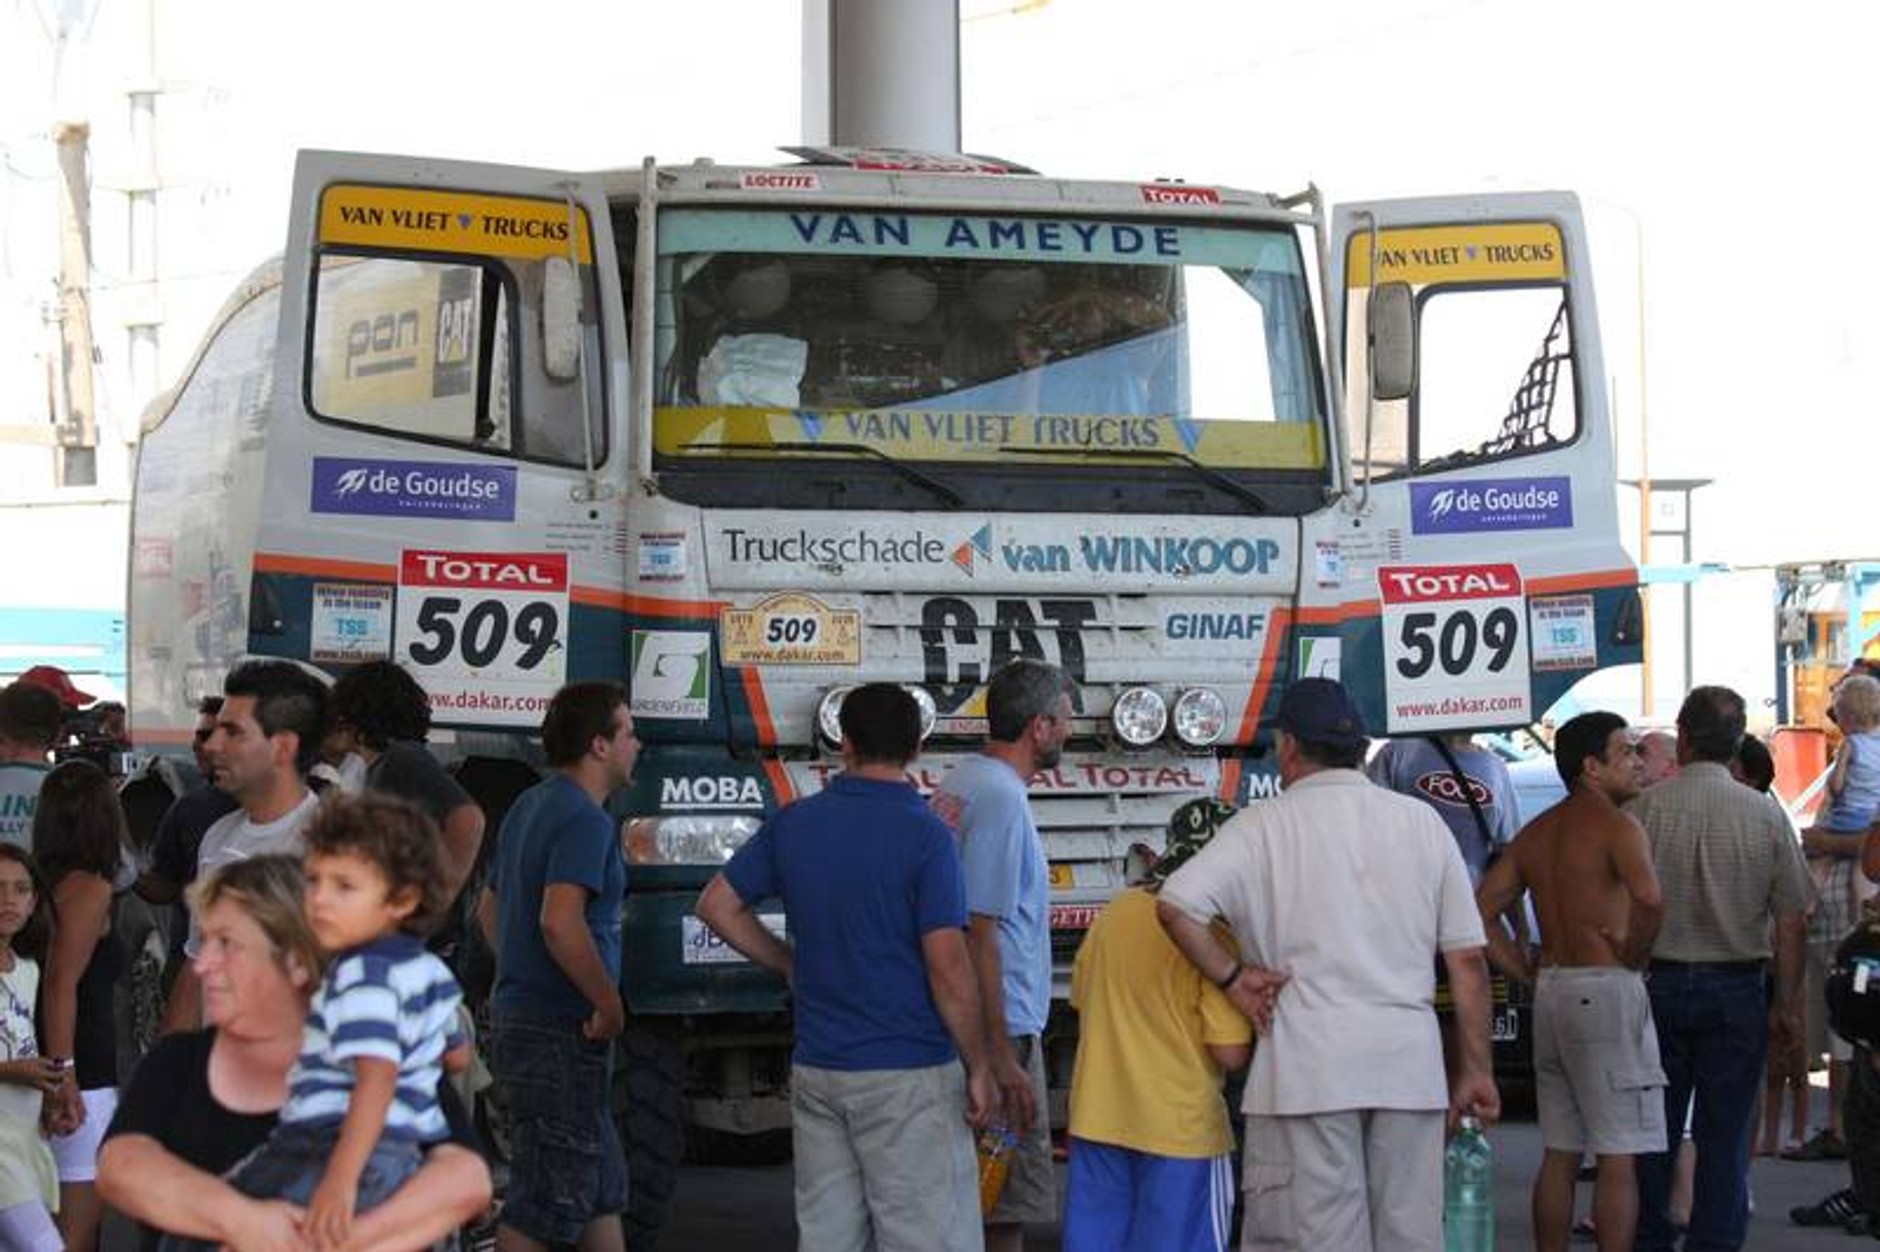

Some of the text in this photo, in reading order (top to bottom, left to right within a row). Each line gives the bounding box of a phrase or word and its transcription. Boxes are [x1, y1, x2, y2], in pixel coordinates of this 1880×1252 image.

[744, 175, 815, 187] LOCTITE
[1149, 189, 1210, 205] TOTAL
[340, 206, 569, 240] VAN VLIET TRUCKS
[789, 213, 1182, 256] VAN AMEYDE
[1411, 247, 1461, 265] VLIET
[1485, 243, 1555, 264] TRUCKS
[842, 413, 1161, 447] VAN VLIET TRUCKS
[369, 470, 500, 499] de Goudse
[1456, 486, 1560, 512] de Goudse
[722, 528, 1280, 575] Truckschade van WINKOOP
[416, 554, 554, 584] TOTAL
[1390, 572, 1511, 598] TOTAL
[408, 597, 559, 670] 509
[767, 616, 818, 643] 509
[1165, 613, 1266, 641] GINAF
[919, 597, 1098, 715] CAT
[1396, 606, 1518, 679] 509
[1396, 694, 1524, 718] www.dakar.com
[661, 776, 764, 803] MOBA
[1076, 763, 1207, 789] TOTAL
